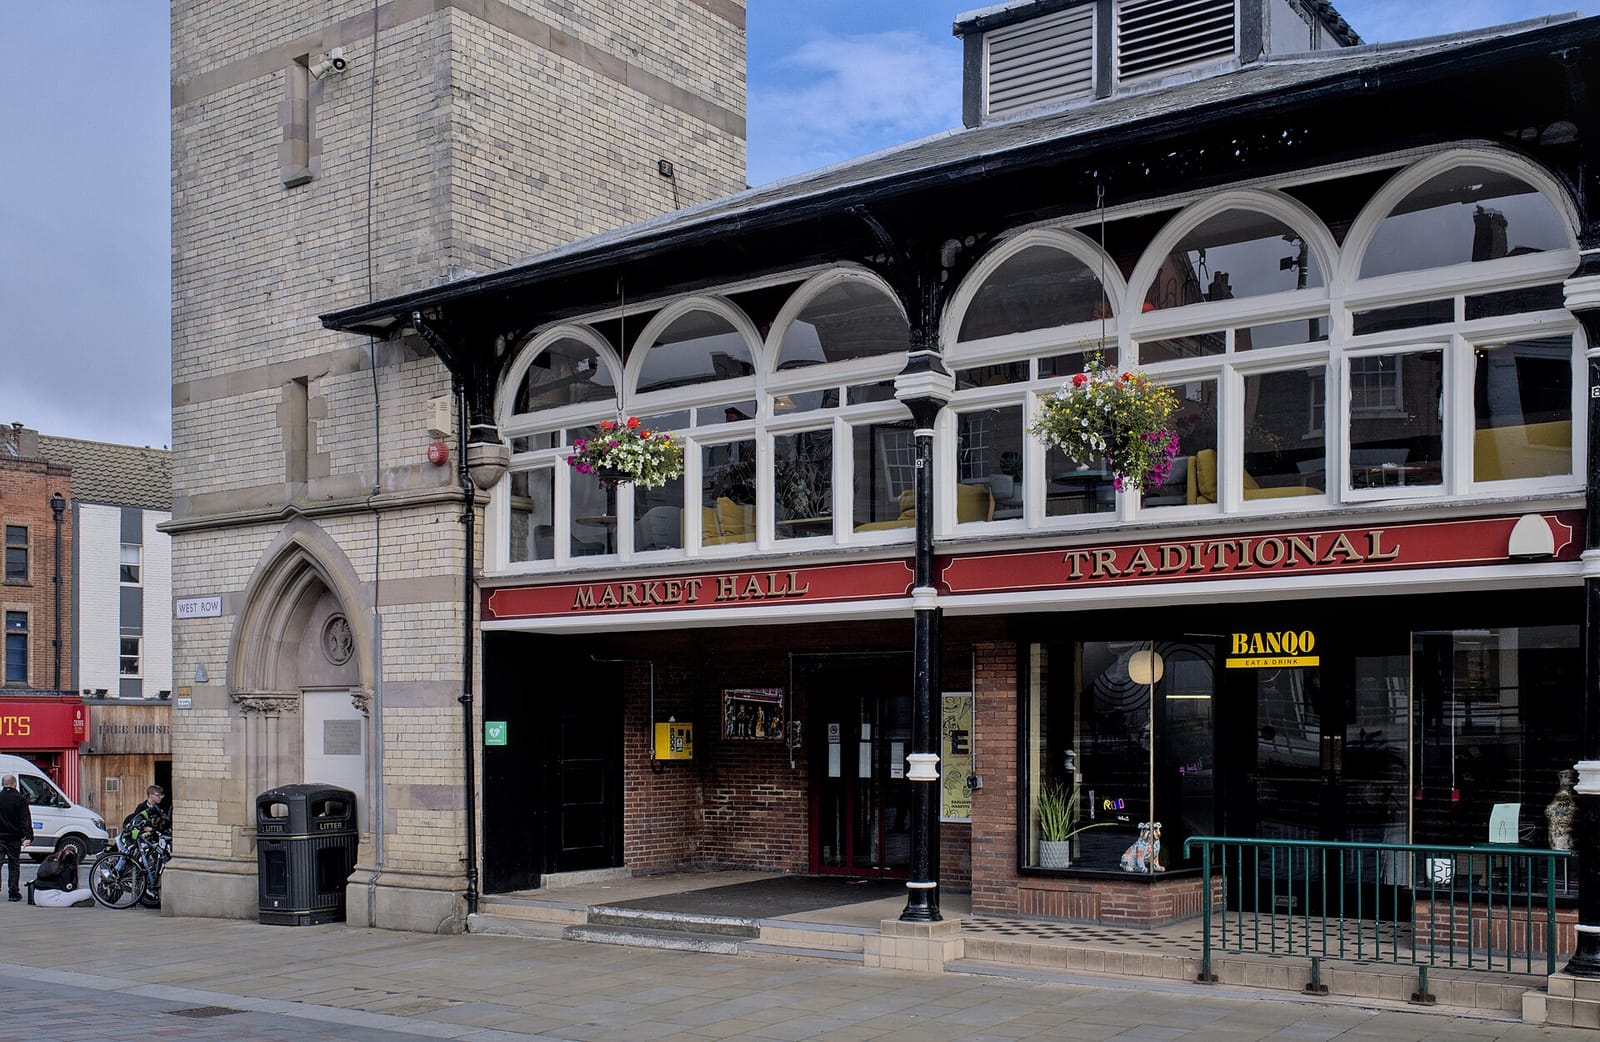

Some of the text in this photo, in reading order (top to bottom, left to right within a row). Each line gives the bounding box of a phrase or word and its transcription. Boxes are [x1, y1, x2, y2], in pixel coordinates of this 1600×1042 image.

[1064, 530, 1400, 580] TRADITIONAL
[572, 572, 809, 610] MARKET HALL
[179, 601, 219, 613] WEST ROW
[1231, 630, 1315, 656] BANQO
[0, 716, 31, 736] TS
[98, 725, 170, 735] FREE HOUSE
[319, 822, 343, 830] LITTER
